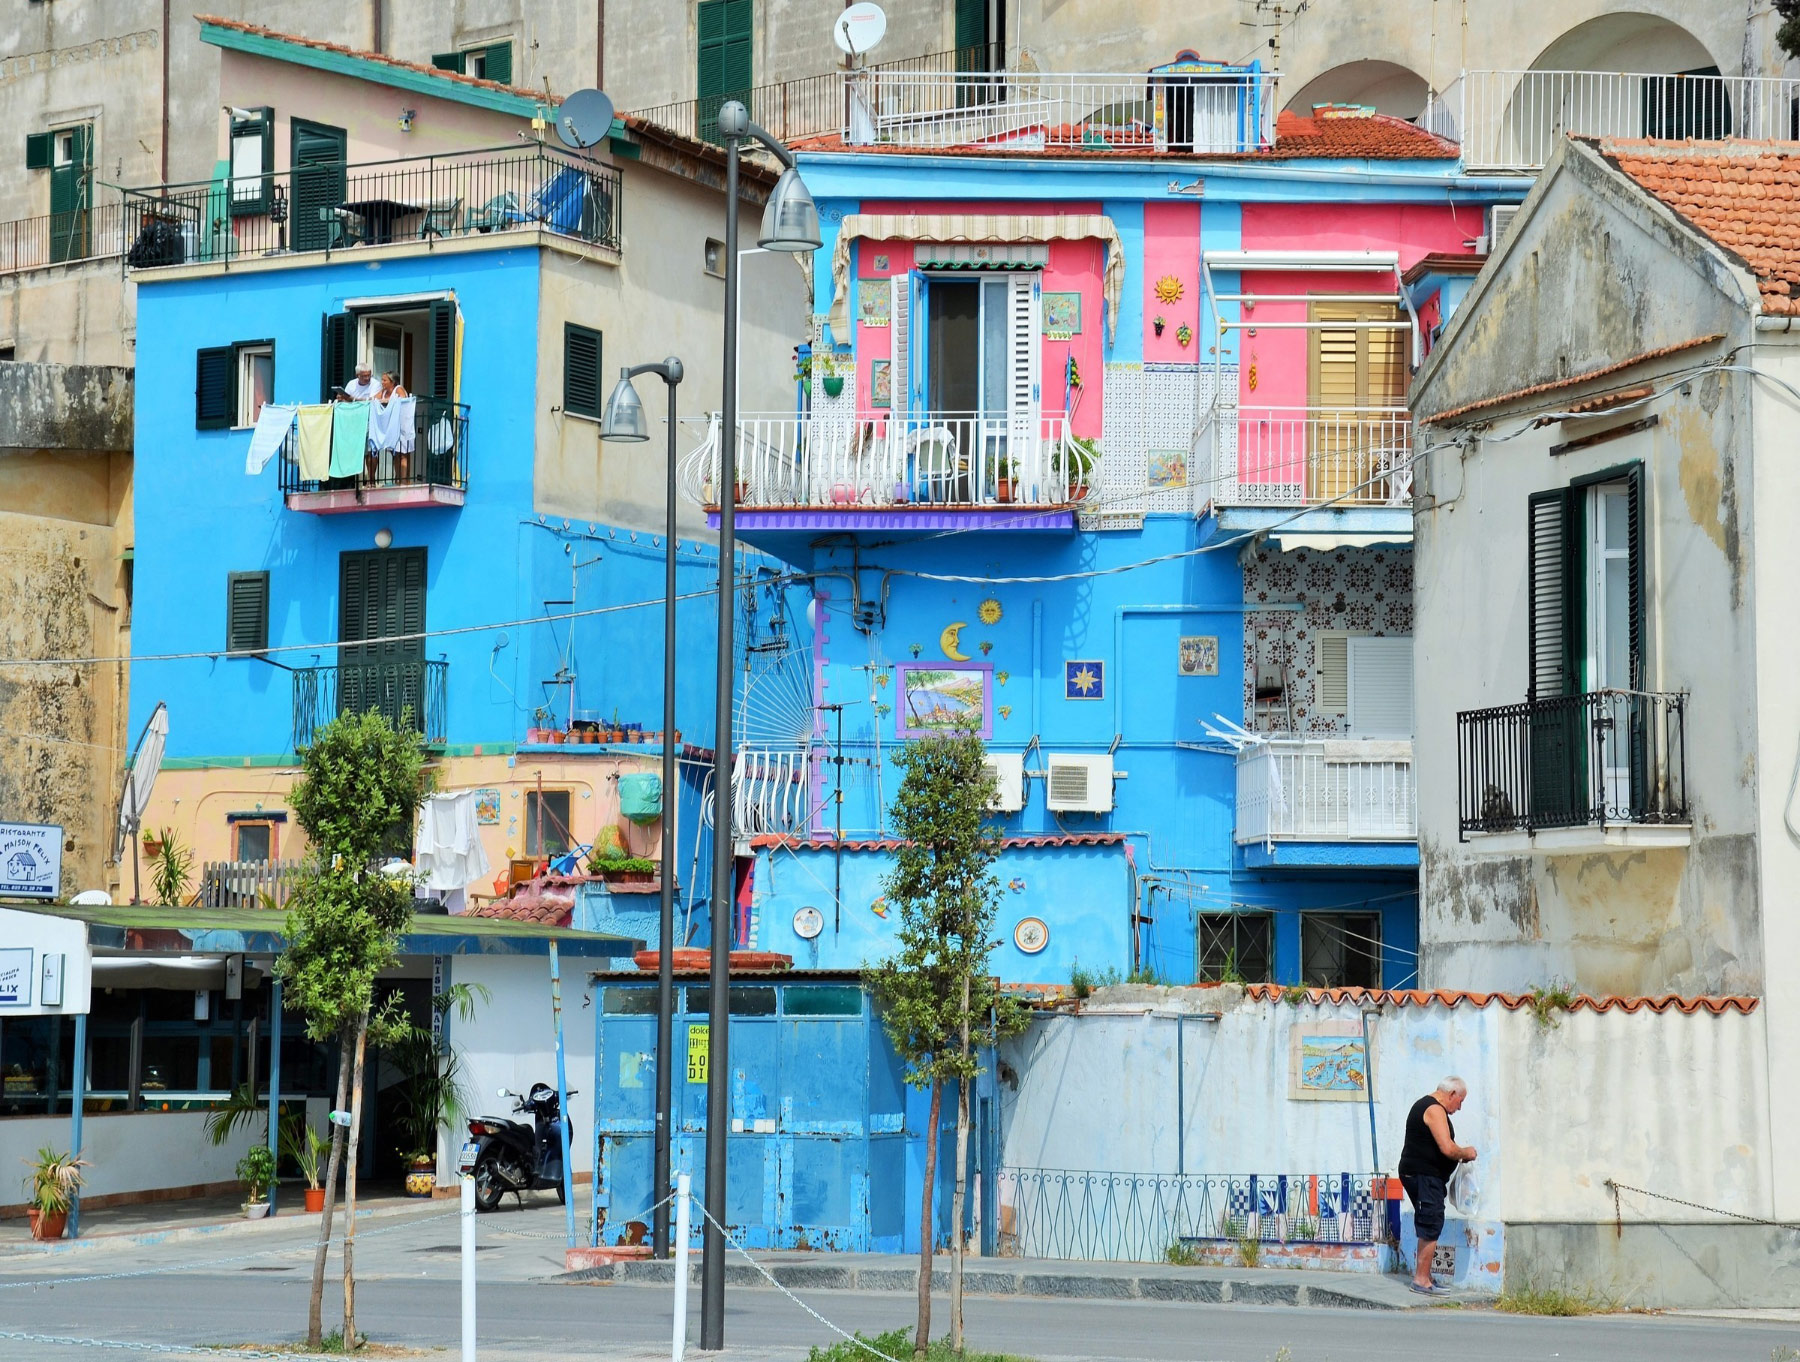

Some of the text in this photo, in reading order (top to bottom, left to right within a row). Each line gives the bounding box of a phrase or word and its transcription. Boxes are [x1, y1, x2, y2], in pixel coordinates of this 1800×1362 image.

[1, 829, 46, 837] RISTORANTE
[4, 839, 50, 865] MAISON FELIX
